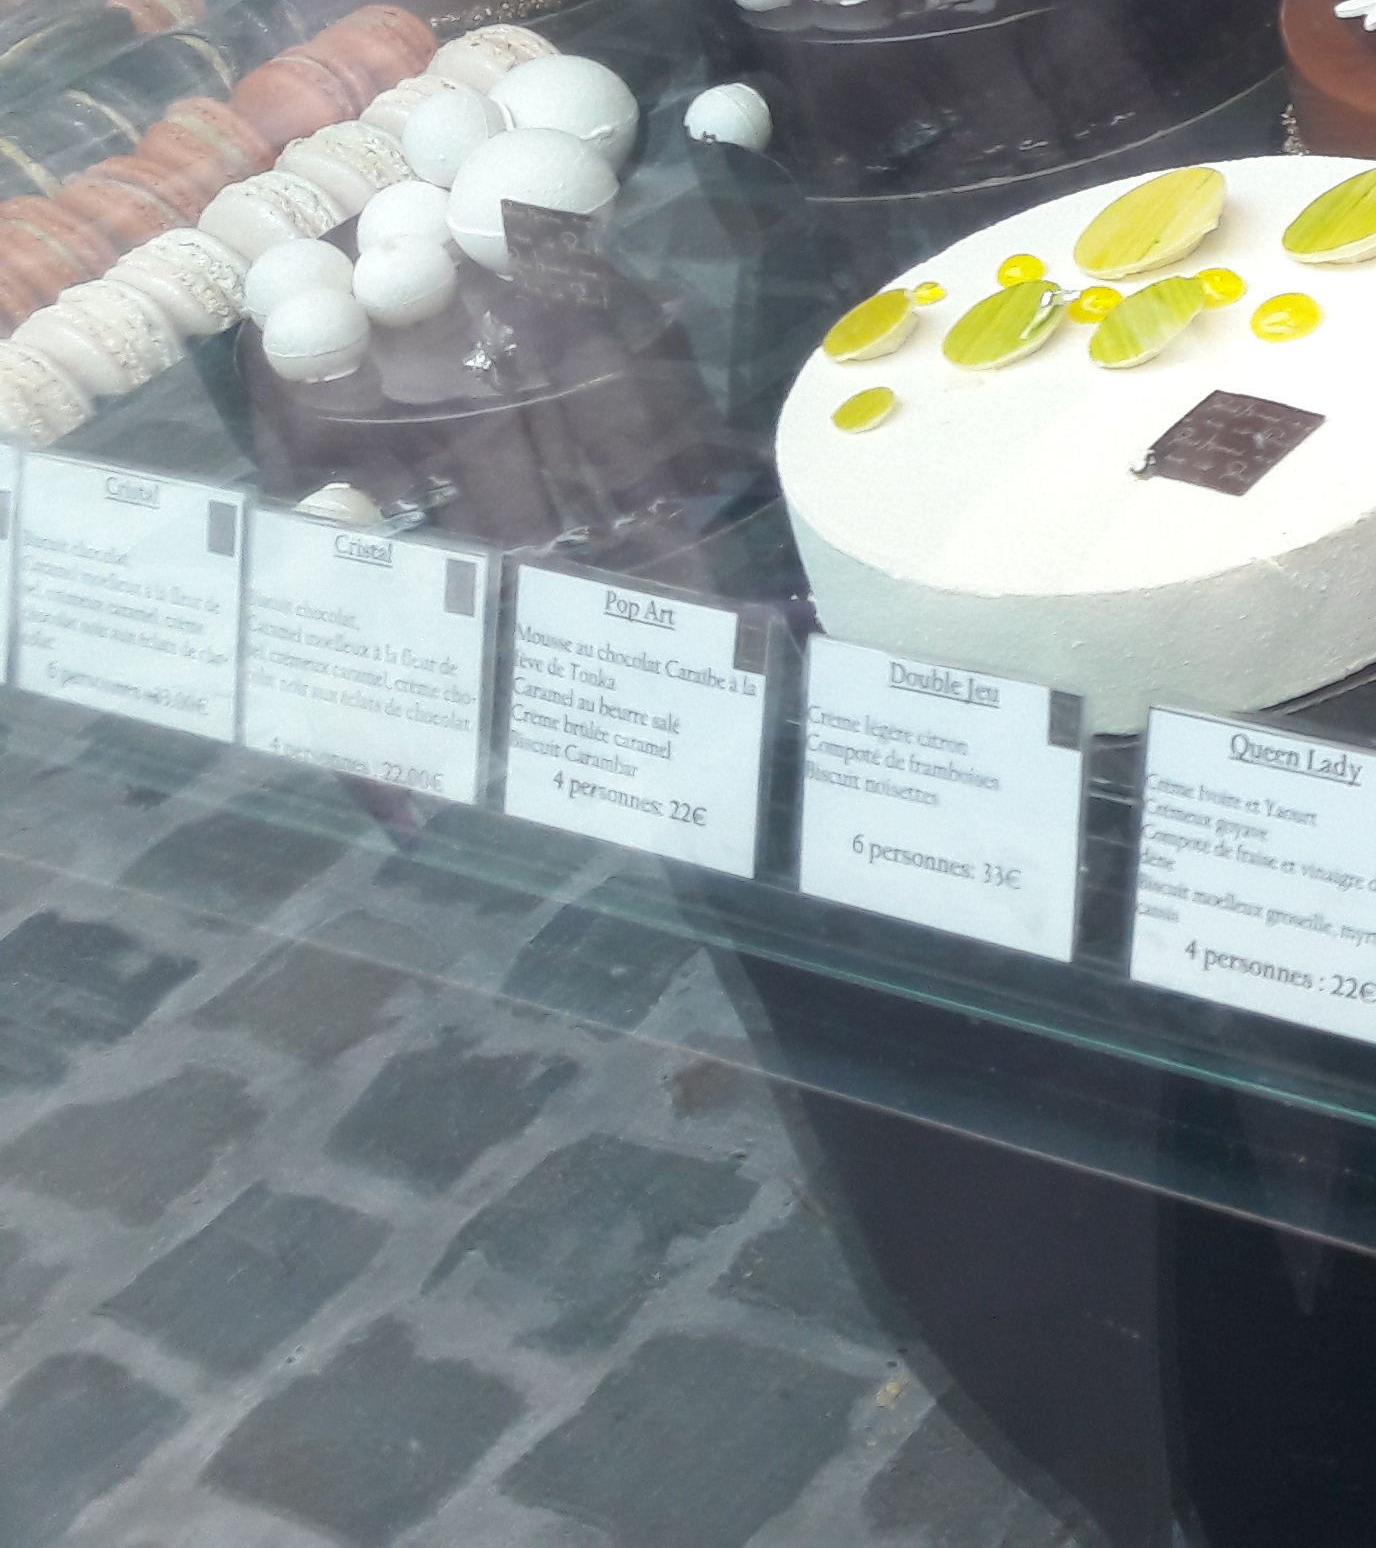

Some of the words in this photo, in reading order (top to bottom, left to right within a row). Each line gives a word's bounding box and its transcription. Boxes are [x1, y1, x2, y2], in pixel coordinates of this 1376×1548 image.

[605, 591, 640, 622] Pop
[645, 601, 674, 625] Art
[513, 677, 573, 707] Caramel
[577, 698, 594, 712] au
[547, 658, 564, 678] de
[571, 663, 615, 690] Tonka
[891, 662, 962, 701] Double
[966, 678, 999, 709] Jeu
[885, 750, 905, 770] de
[1230, 734, 1300, 773] Queen
[1306, 749, 1362, 786] Lady
[554, 770, 564, 789] 4
[670, 801, 706, 826] 22€
[853, 834, 864, 853] 6
[984, 863, 1021, 889] 33€
[1185, 940, 1197, 959] 4
[1204, 950, 1312, 988] personnes
[1331, 975, 1376, 1002] 22€
